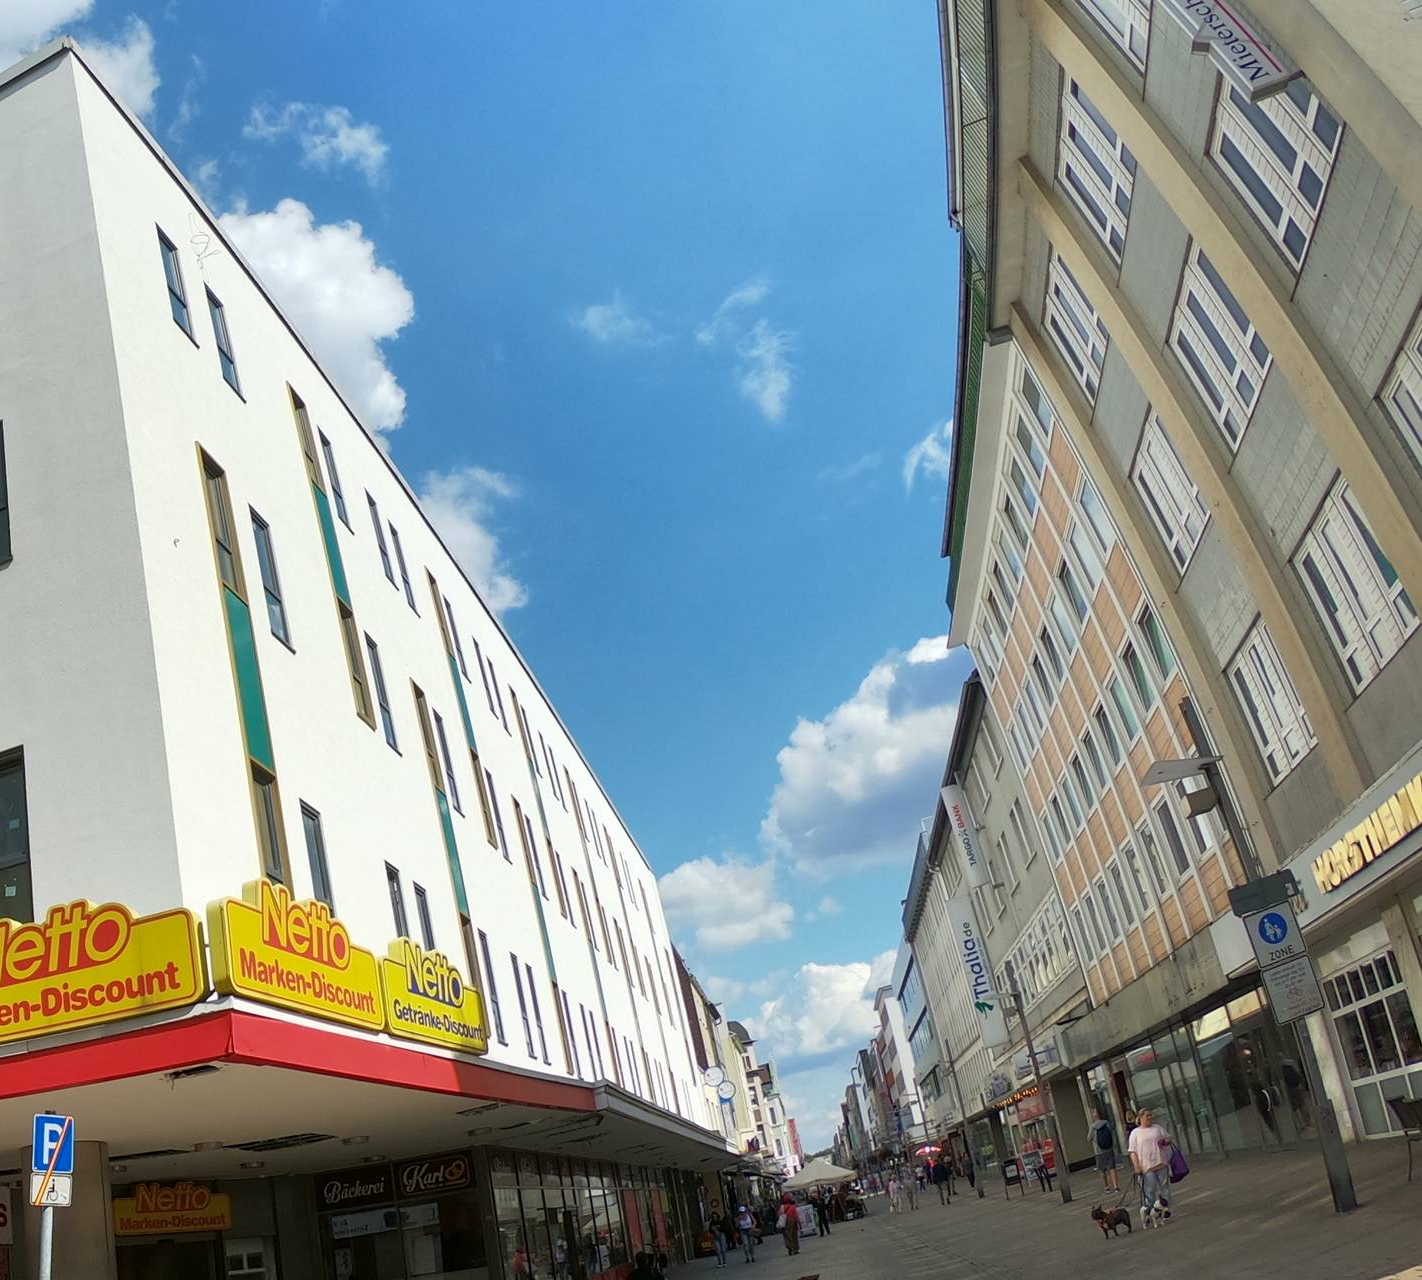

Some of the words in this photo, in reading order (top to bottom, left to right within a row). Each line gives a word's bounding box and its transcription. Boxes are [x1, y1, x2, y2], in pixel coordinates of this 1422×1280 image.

[263, 880, 351, 970] Netto
[1269, 945, 1295, 961] ZONE
[239, 947, 377, 1015] Marken-Discount
[404, 941, 465, 1008] Netto
[393, 999, 483, 1043] Getränke-Discount
[136, 1182, 210, 1213] Netto
[323, 1177, 386, 1203] Bäckerei
[402, 1162, 445, 1193] Karl
[119, 1213, 227, 1231] Marken-Discount
